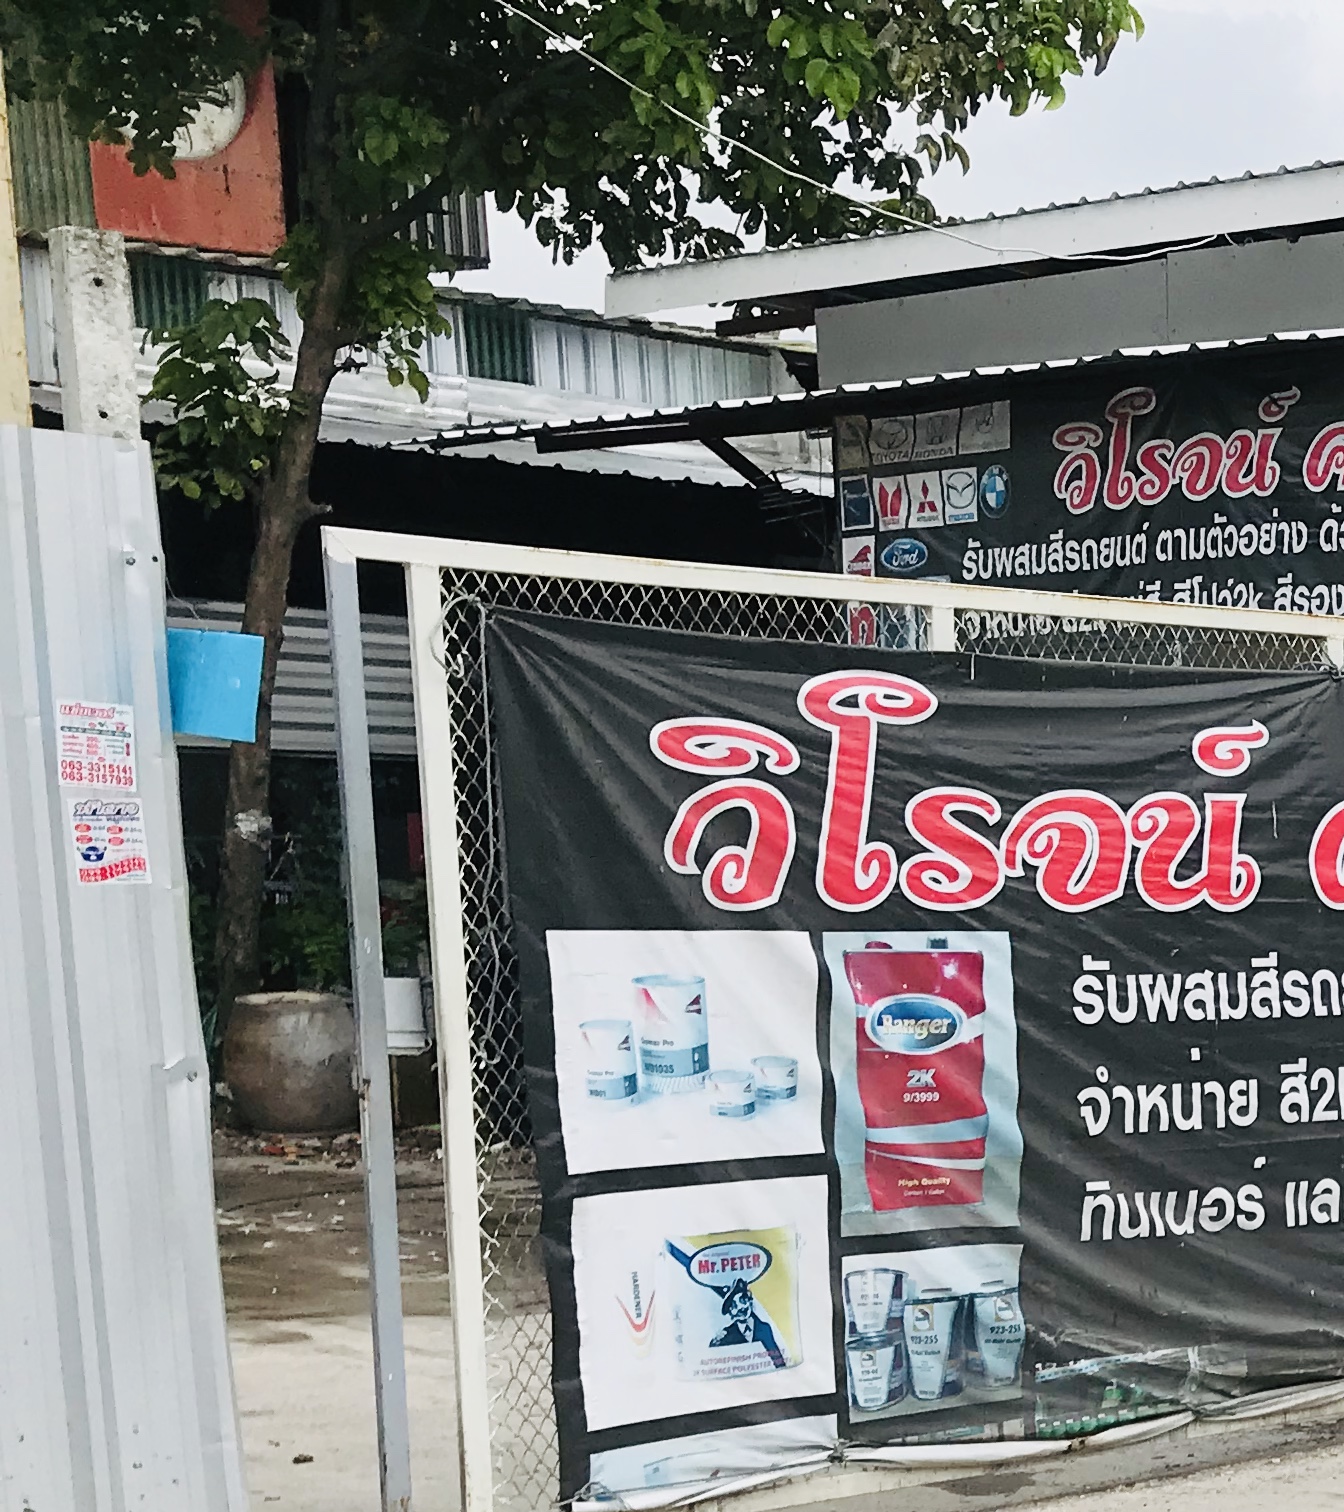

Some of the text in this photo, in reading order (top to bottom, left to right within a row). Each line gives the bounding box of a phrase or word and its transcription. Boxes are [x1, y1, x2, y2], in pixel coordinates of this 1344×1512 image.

[1052, 386, 1301, 514] วิโรจน์
[892, 548, 919, 567] Ford
[961, 522, 1148, 581] รับผสมสีรถยนต์
[1155, 508, 1308, 560] ตามตัวอย่าง
[649, 670, 1272, 912] วิโรจน์
[881, 1014, 953, 1040] Ranger
[903, 1091, 940, 1103] 9/3999
[906, 1068, 937, 1088] 2K
[1076, 1047, 1259, 1136] จำหน่าย
[898, 1177, 951, 1188] High Quality
[1080, 1156, 1266, 1242] ทินเนอร์
